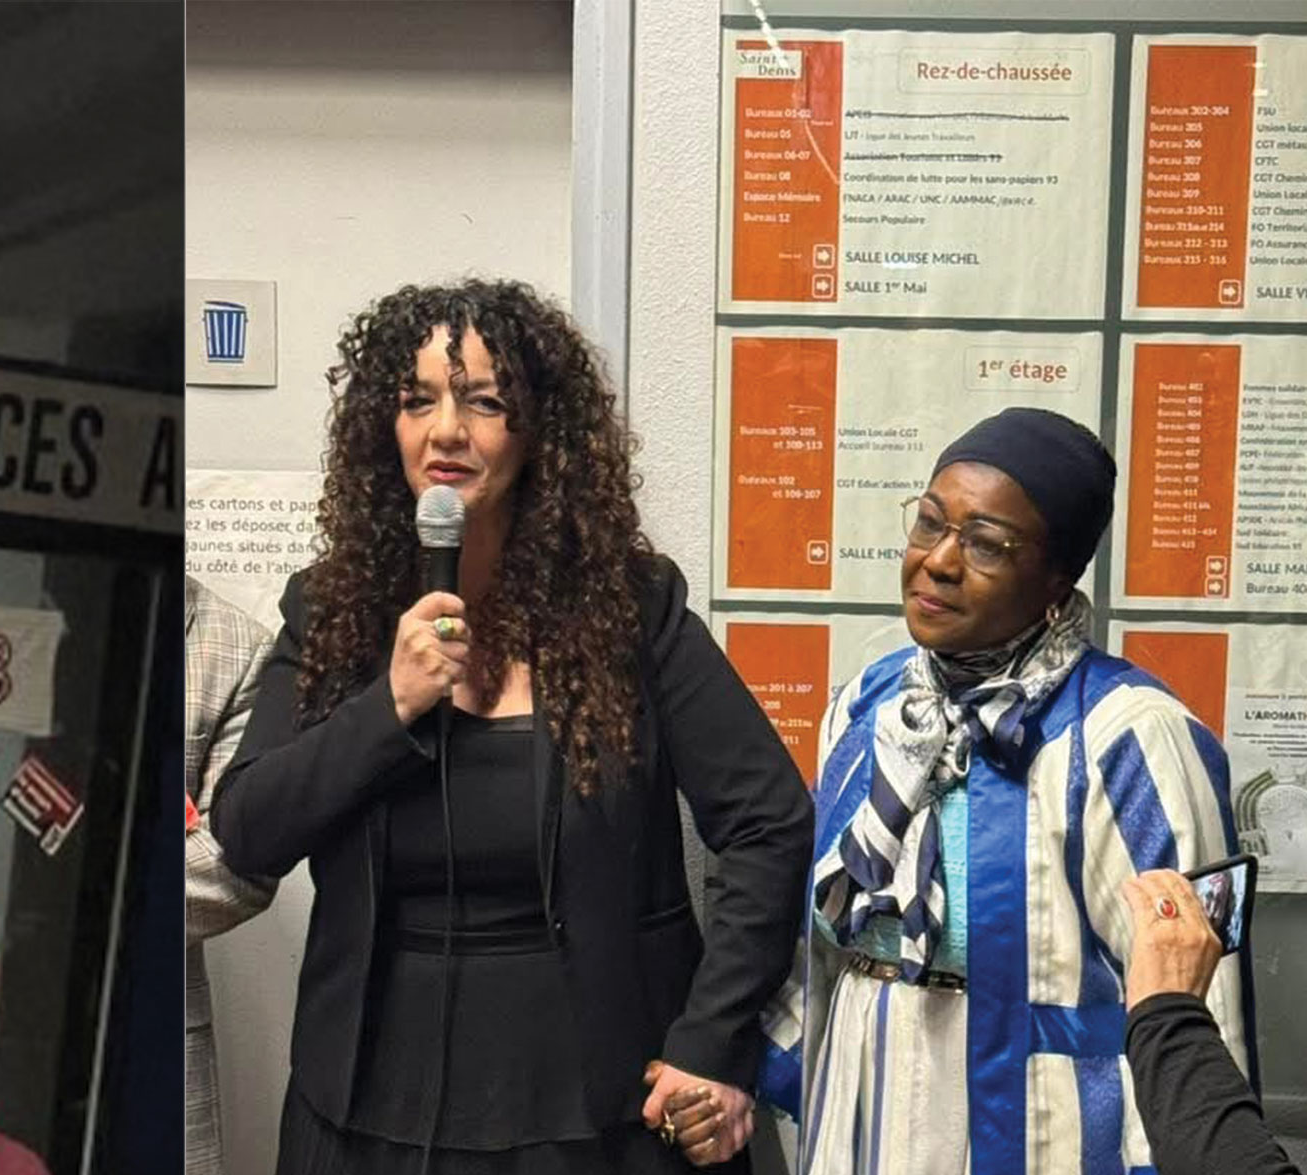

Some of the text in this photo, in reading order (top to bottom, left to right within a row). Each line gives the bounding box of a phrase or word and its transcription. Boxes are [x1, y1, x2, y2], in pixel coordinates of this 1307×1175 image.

[916, 62, 1073, 81] Rez-de-chaussée
[1255, 140, 1276, 149] CGT
[844, 172, 905, 182] Coordination
[906, 173, 919, 182] de
[920, 173, 943, 183] lutte
[945, 175, 967, 185] pour
[970, 174, 983, 184] les
[1253, 173, 1273, 182] CGT
[1252, 206, 1271, 216] CGT
[880, 214, 926, 225] Populaire
[845, 251, 980, 265] SALLE LOUISE MICHEL
[844, 281, 880, 293] SALLE
[903, 281, 927, 294] Mai
[1256, 286, 1293, 299] SALLE
[1009, 360, 1068, 383] étage
[838, 428, 866, 437] Union
[899, 428, 919, 437] CGT
[837, 479, 856, 488] CGT
[209, 499, 265, 512] cartons
[269, 499, 284, 511] et
[206, 518, 227, 531] les
[238, 540, 282, 553] situés
[839, 548, 907, 559] SALLE HEN
[185, 560, 202, 572] du
[207, 558, 238, 573] côté
[243, 560, 262, 573] de
[1246, 562, 1282, 574] SALLE
[1246, 582, 1289, 594] Bureau
